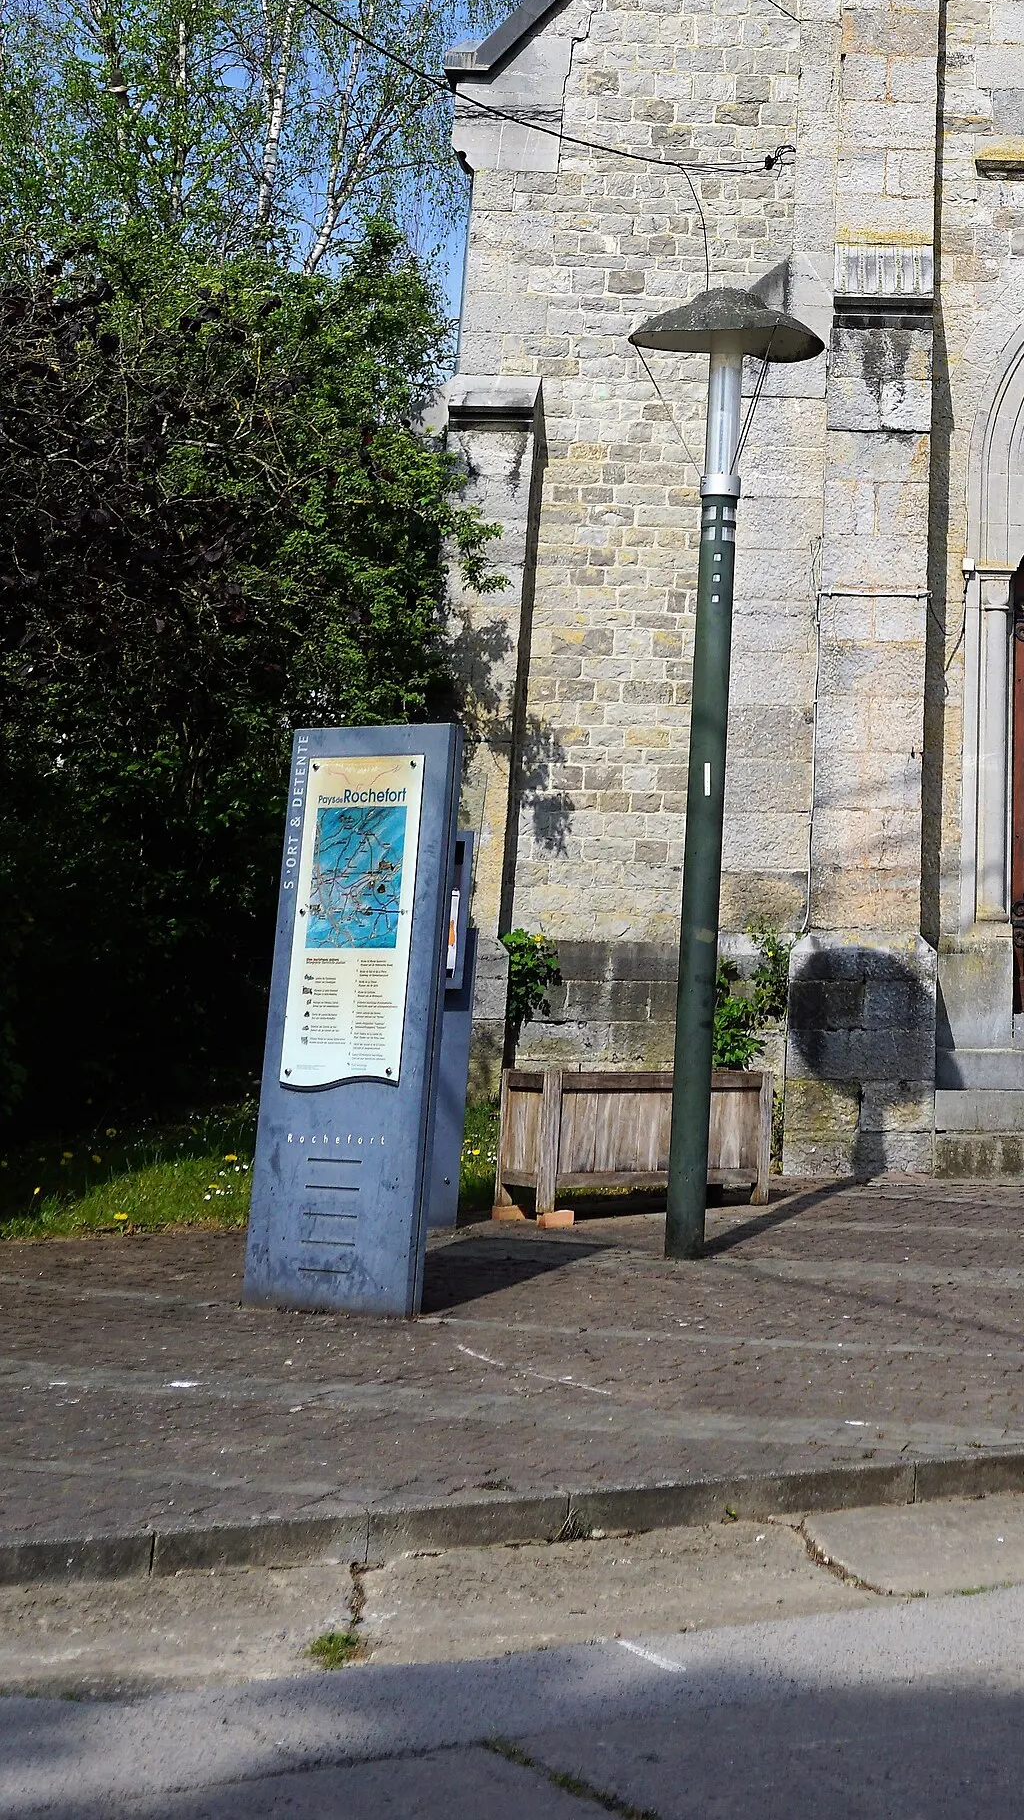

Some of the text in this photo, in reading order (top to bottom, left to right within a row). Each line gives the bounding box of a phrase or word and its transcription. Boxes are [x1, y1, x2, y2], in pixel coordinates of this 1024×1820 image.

[292, 735, 309, 808] DETENTE
[343, 787, 407, 803] Rochefort
[290, 816, 301, 828] &
[287, 1132, 386, 1146] Rochefort
